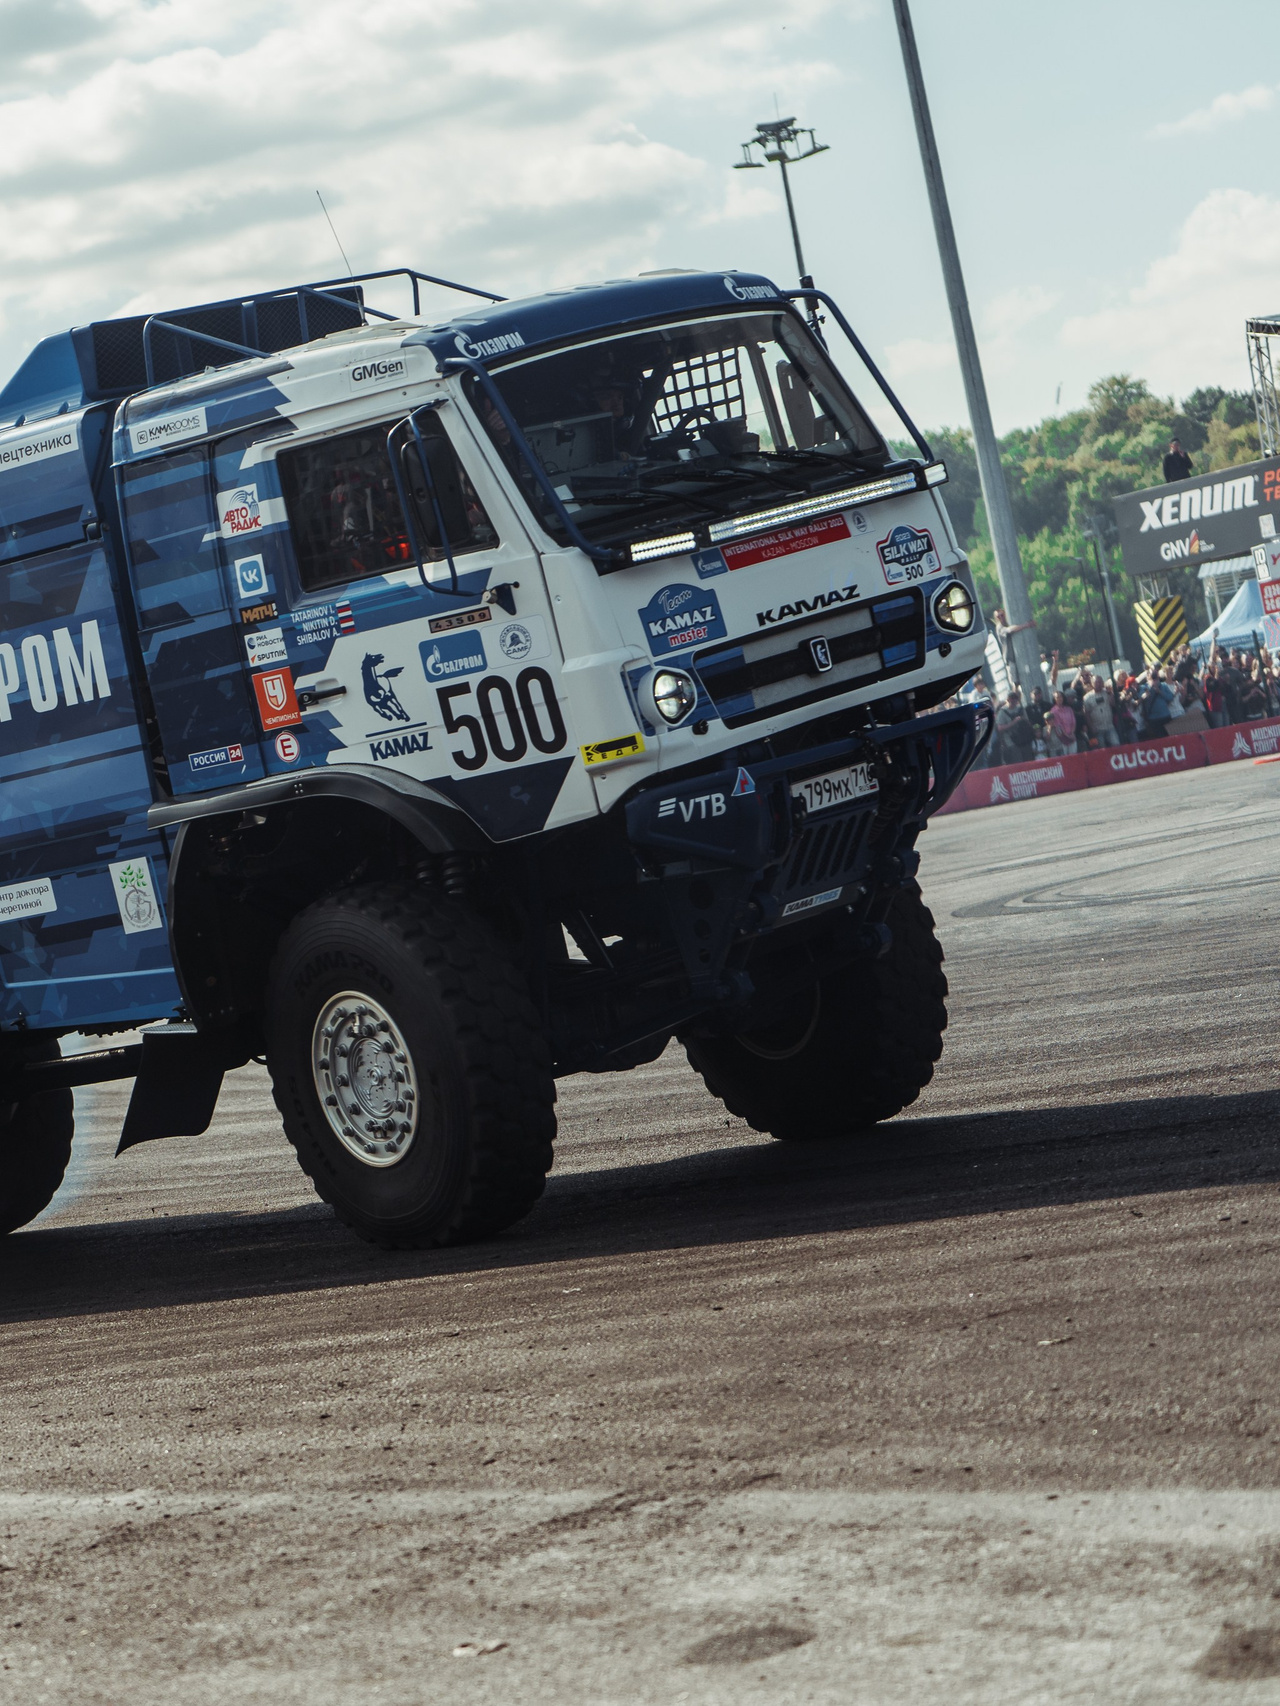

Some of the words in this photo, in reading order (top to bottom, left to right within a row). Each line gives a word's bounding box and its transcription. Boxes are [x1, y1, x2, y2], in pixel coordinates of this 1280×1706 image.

[478, 331, 525, 357] ГАЗПРОМ
[351, 360, 404, 381] GMGen
[1139, 475, 1259, 533] XENUM
[223, 507, 249, 524] АВТО
[723, 534, 779, 557] INTERNATIONAL
[779, 530, 793, 542] SILK
[793, 526, 809, 540] WAY
[808, 522, 828, 536] RALLY
[828, 517, 844, 531] 2023
[894, 531, 911, 542] 2023
[761, 546, 786, 559] KAZAN
[790, 536, 819, 551] MOSCOW
[883, 543, 909, 561] SILK
[908, 537, 928, 553] WAY
[1160, 537, 1190, 561] GNV
[242, 568, 259, 584] VK
[905, 564, 924, 581] 500
[657, 588, 692, 614] Team
[756, 584, 861, 627] KAMAZ
[290, 607, 329, 623] TATARINOV
[302, 618, 329, 632] NIKITIN
[329, 616, 338, 625] D.
[434, 611, 487, 630] 43509
[648, 605, 716, 637] KAMAZ
[297, 630, 331, 646] SHIBALOV
[332, 628, 341, 637] A.
[668, 626, 708, 647] master
[257, 648, 287, 662] SPUTNIK
[442, 654, 484, 674] GAZPROM
[264, 711, 299, 725] ЧЕМПИОНАТ
[435, 665, 567, 771] 500
[279, 737, 295, 758] E
[369, 731, 434, 762] KAMAZ
[193, 752, 227, 767] РОССИЯ
[230, 748, 241, 758] 24
[1110, 745, 1186, 770] auto.ru
[678, 792, 727, 823] VTB
[16, 884, 49, 899] доктора
